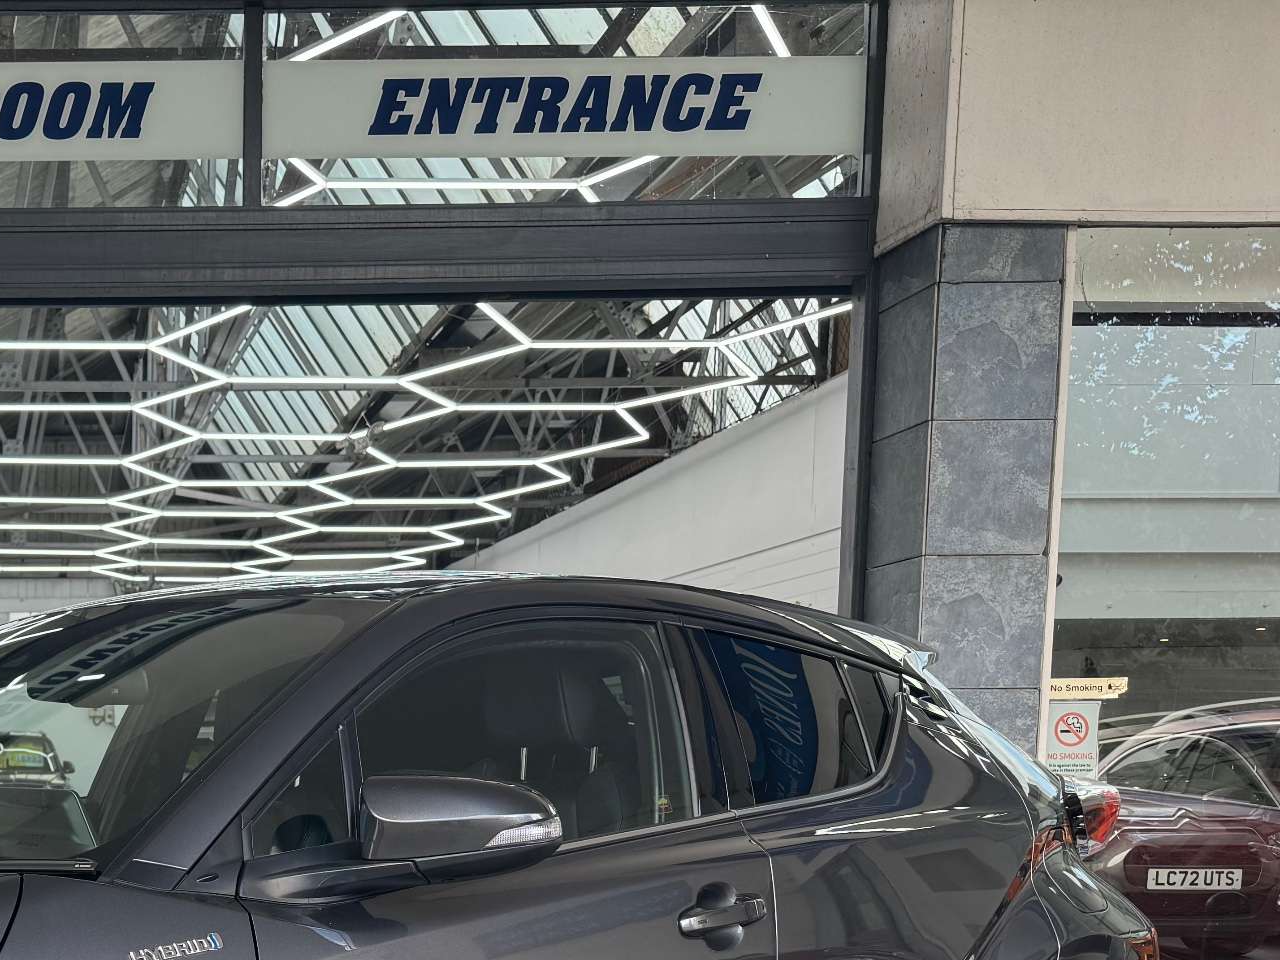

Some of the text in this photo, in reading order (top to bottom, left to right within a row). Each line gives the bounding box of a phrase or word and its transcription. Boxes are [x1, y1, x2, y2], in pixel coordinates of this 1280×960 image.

[367, 73, 763, 136] ENTRANCE
[1050, 683, 1103, 693] No Smoking
[1048, 752, 1058, 760] NO
[1154, 870, 1235, 887] LC72 UTS
